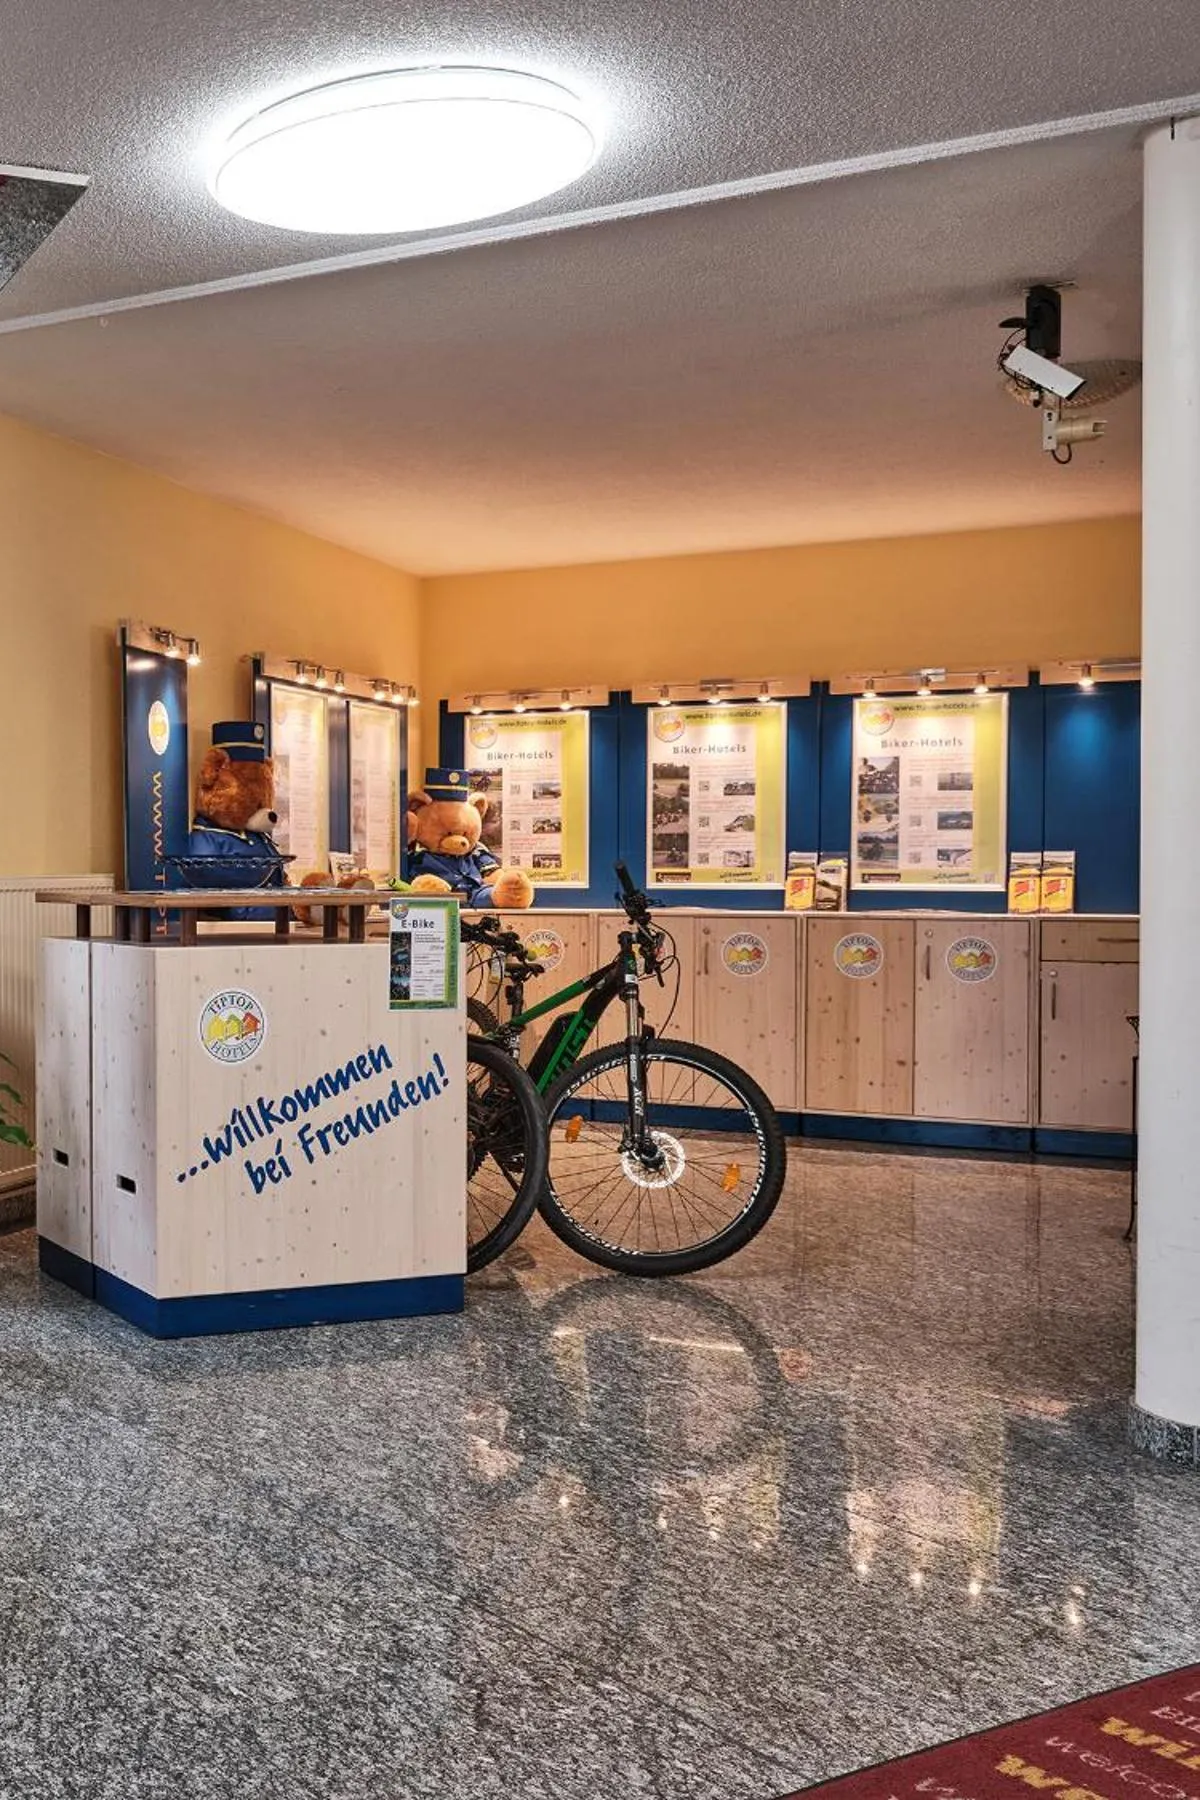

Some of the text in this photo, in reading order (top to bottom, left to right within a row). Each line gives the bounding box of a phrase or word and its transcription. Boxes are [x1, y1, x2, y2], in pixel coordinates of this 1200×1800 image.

[672, 743, 748, 755] Biker-Hotels
[881, 737, 964, 749] Biker-Hotels
[486, 750, 554, 762] Biker-Hotels
[401, 919, 435, 929] E-Bike
[210, 1037, 258, 1058] HOTELS
[244, 1052, 450, 1194] bei Freunden!
